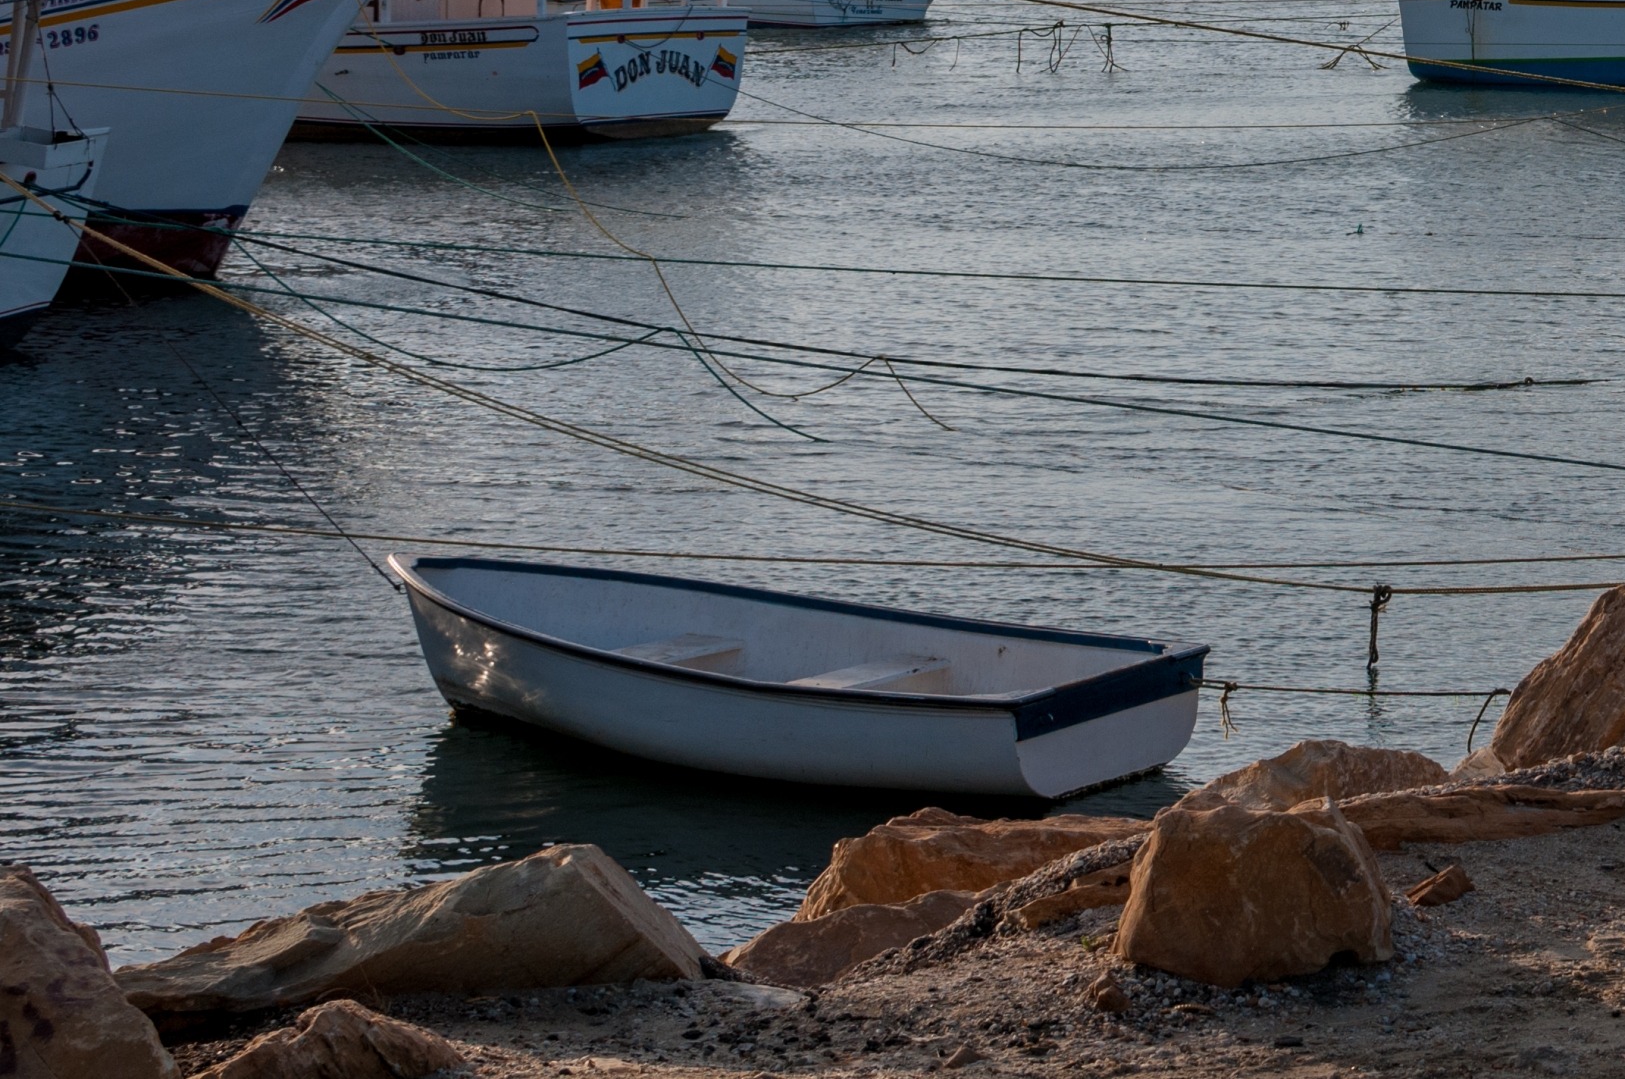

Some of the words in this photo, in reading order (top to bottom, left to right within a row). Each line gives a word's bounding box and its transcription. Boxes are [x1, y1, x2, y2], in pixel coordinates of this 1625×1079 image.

[47, 24, 100, 49] 2896
[614, 51, 652, 92] DON
[656, 50, 705, 87] JUAN
